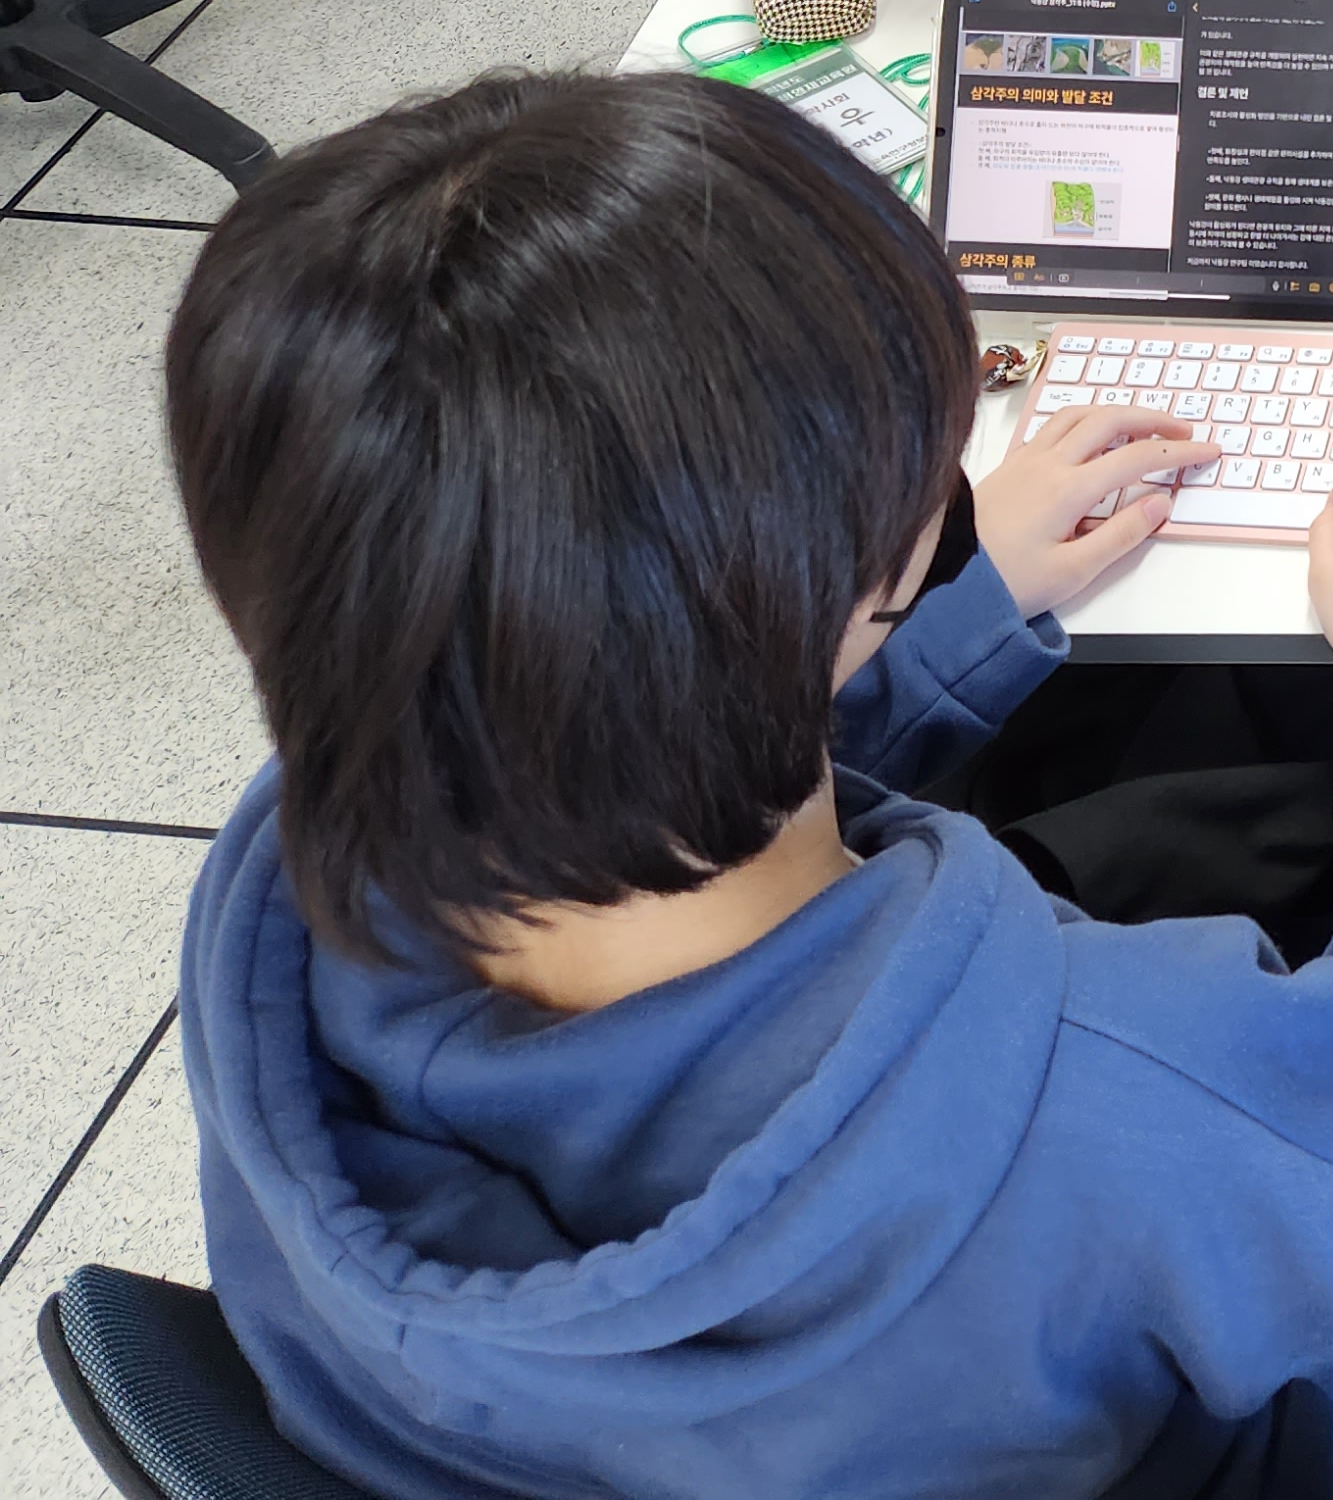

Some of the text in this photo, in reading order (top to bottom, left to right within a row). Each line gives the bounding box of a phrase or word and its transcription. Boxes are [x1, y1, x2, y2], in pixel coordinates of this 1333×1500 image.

[970, 86, 1113, 106] 삼각주의 의미와 발달 조건
[1230, 87, 1249, 100] 제언
[840, 107, 876, 128] 우
[960, 253, 1036, 269] 삼각주의 종류
[1106, 392, 1116, 402] Q
[1147, 393, 1158, 403] W
[1185, 396, 1194, 405] E
[1224, 398, 1234, 407] R
[1264, 400, 1272, 409] T
[1303, 401, 1311, 410] Y
[1223, 429, 1312, 443] F G H
[1234, 462, 1242, 472] V
[1274, 465, 1282, 474] B
[1313, 467, 1322, 476] N
